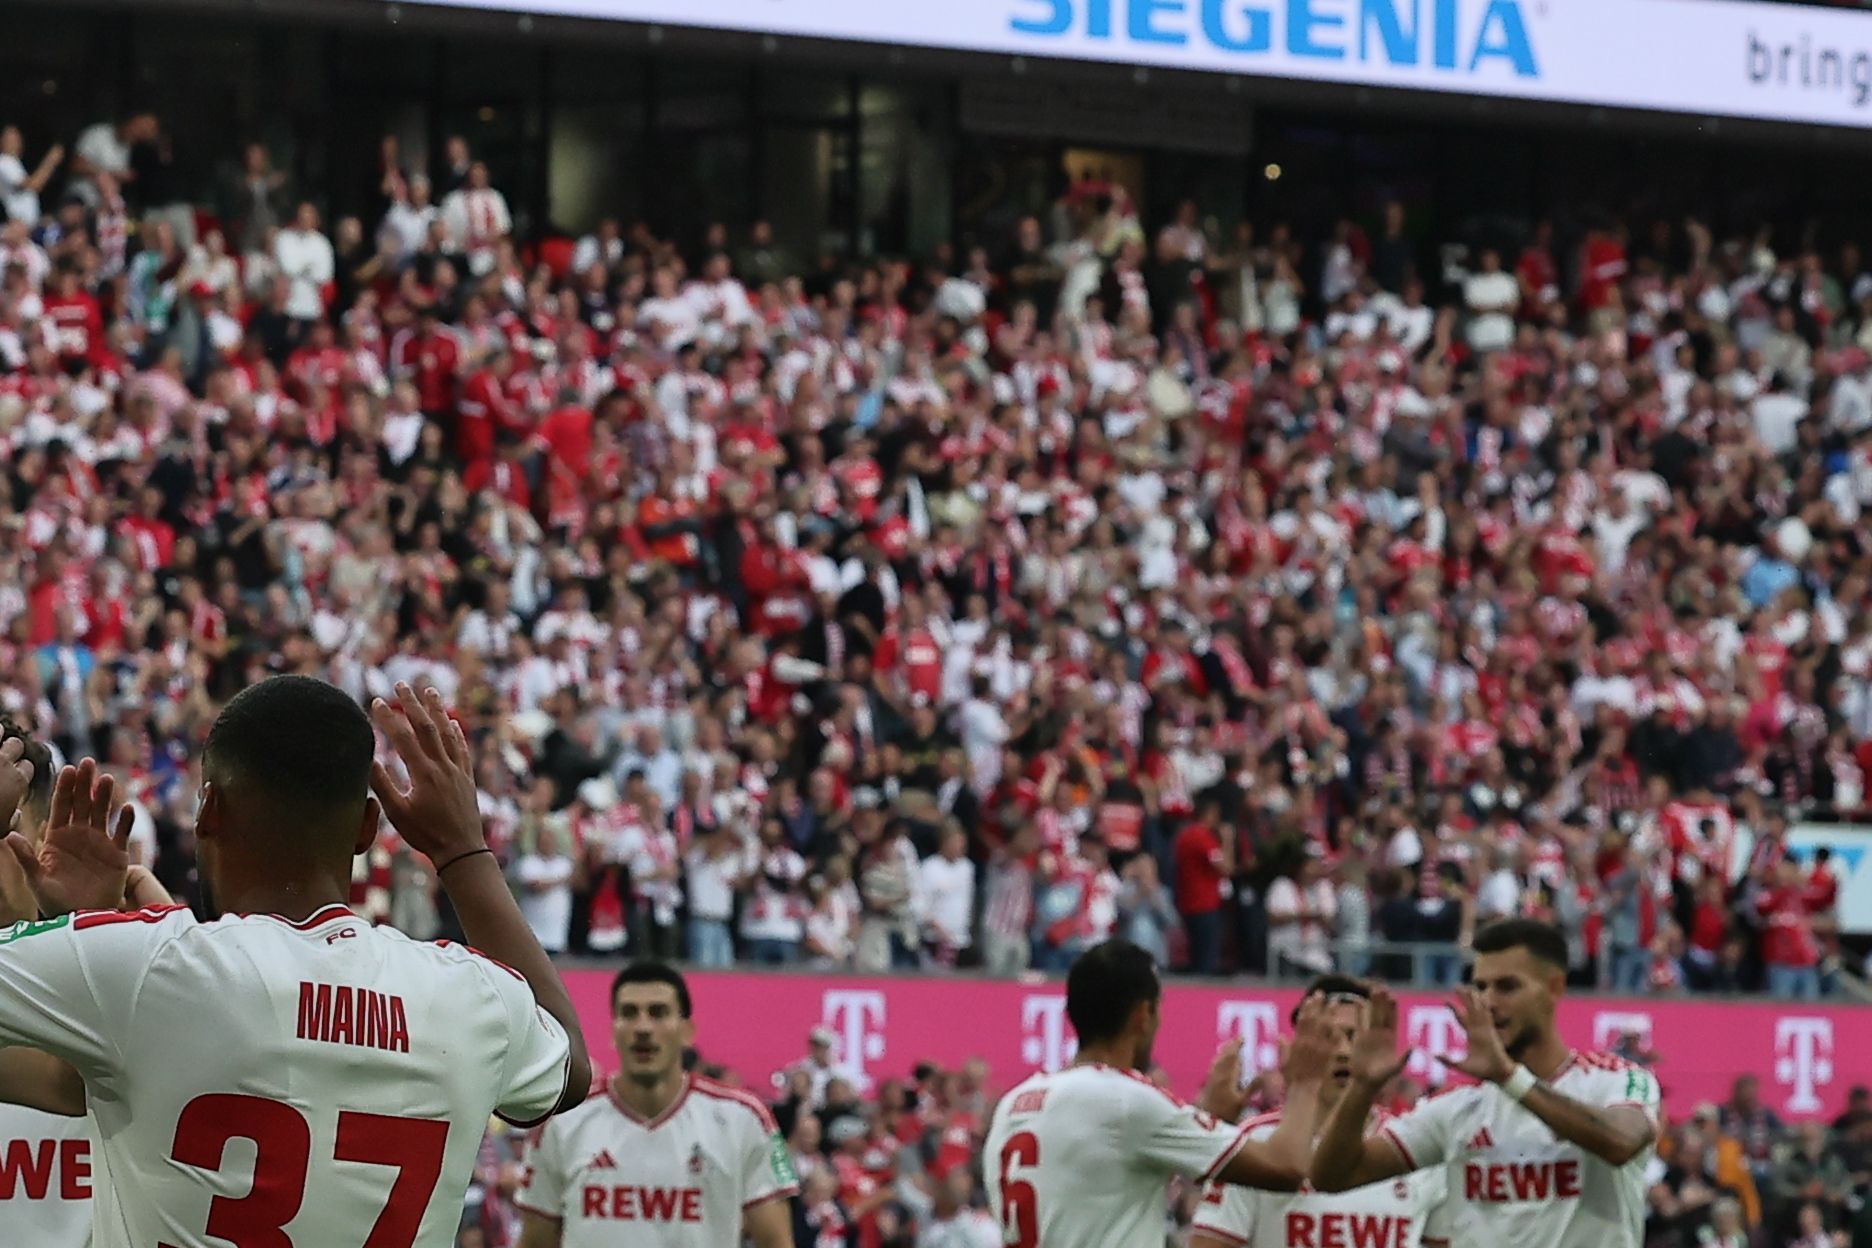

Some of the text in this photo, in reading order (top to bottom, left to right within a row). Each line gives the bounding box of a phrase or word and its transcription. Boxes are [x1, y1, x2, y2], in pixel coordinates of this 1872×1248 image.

[326, 928, 357, 946] FC
[296, 981, 409, 1053] MAINA
[822, 990, 886, 1092] T
[1217, 1001, 1278, 1090] T
[1775, 1017, 1833, 1112] T
[582, 1184, 702, 1223] REWE
[1465, 1159, 1582, 1202] REWE
